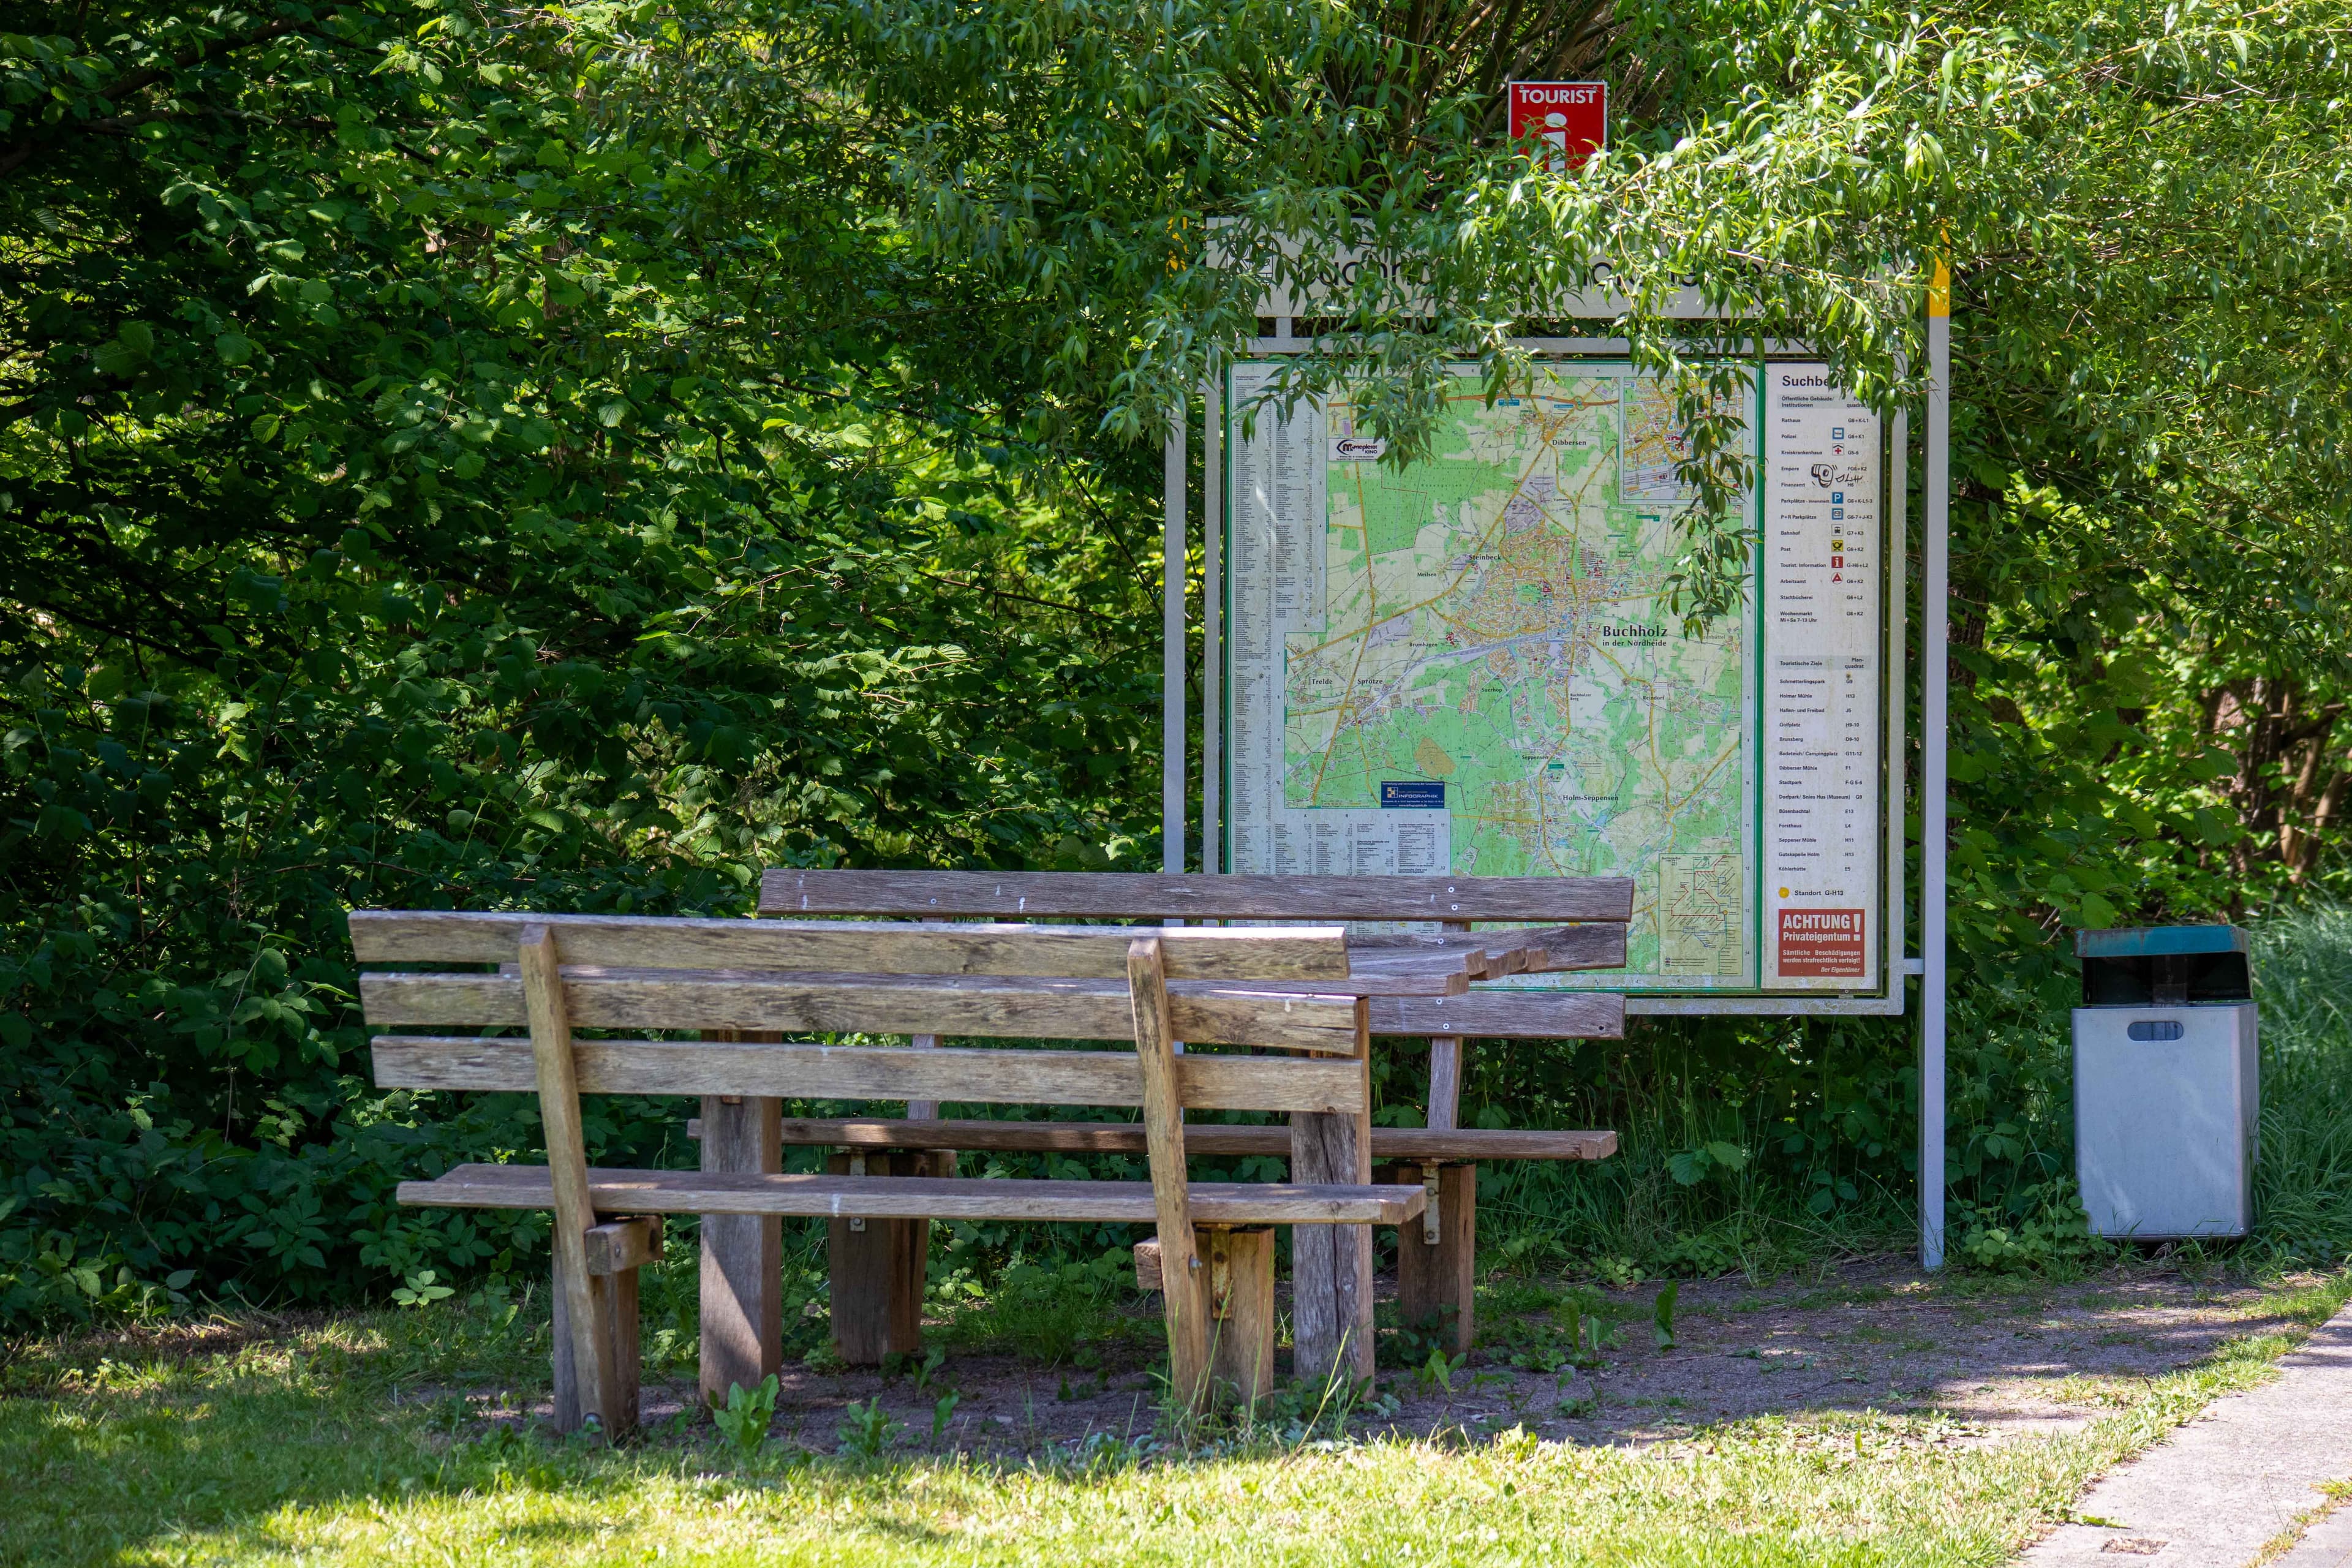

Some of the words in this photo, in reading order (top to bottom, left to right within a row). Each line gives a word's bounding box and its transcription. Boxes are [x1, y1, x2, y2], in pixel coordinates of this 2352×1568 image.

[1520, 89, 1596, 104] TOURIST
[1603, 625, 1667, 636] Buchholz
[1783, 914, 1850, 929] ACHTUNG
[1783, 932, 1850, 943] Privateigentum
